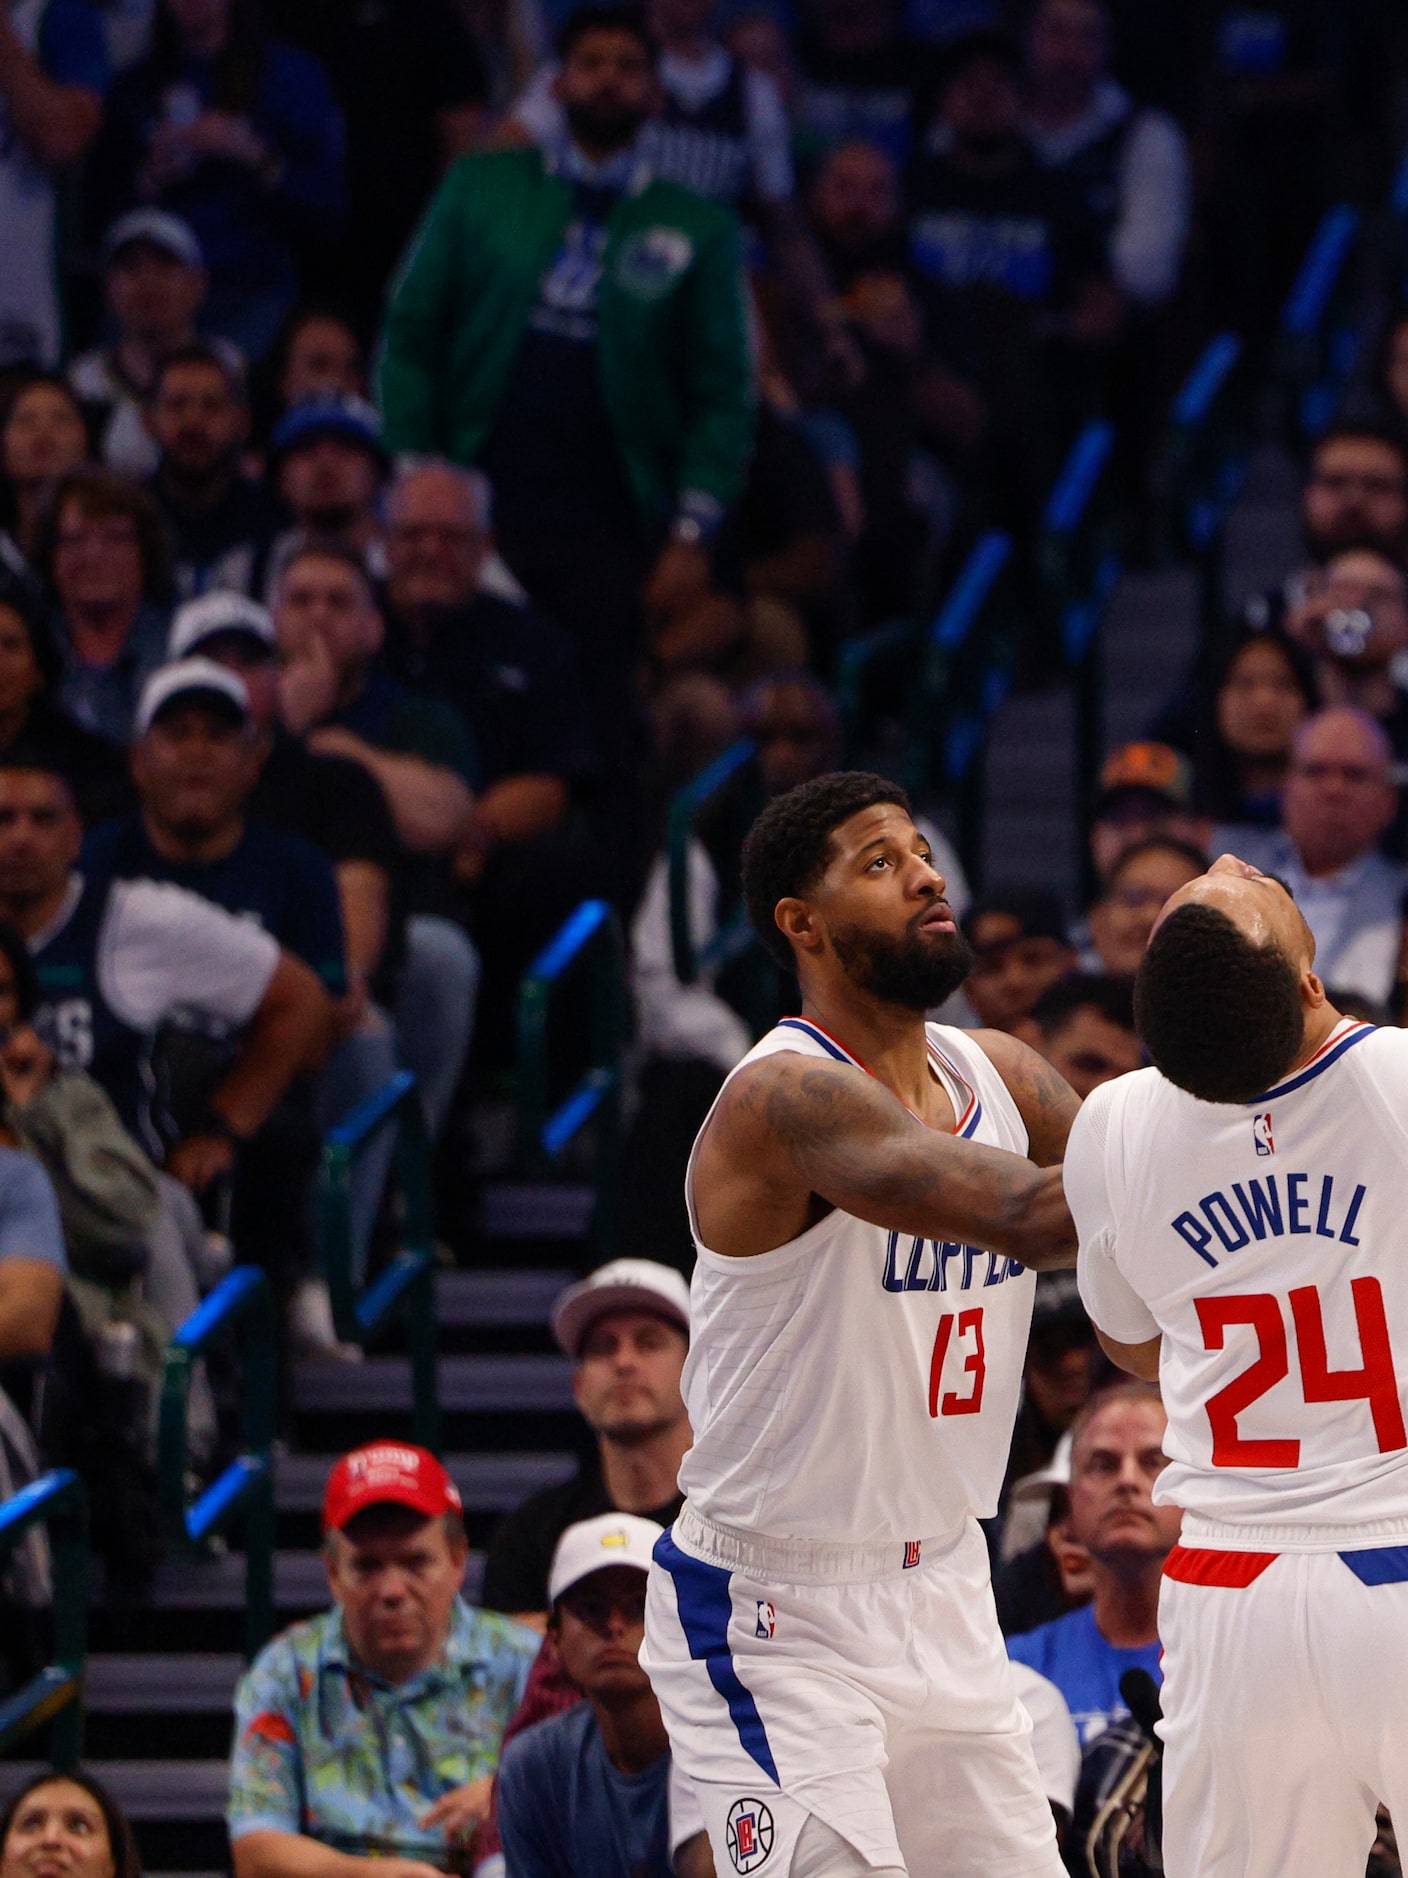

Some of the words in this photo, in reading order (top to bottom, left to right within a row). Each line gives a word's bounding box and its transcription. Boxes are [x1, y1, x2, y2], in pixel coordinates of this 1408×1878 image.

[1171, 1173, 1367, 1268] POWELL
[928, 1307, 986, 1418] 13
[1193, 1276, 1408, 1468] 24
